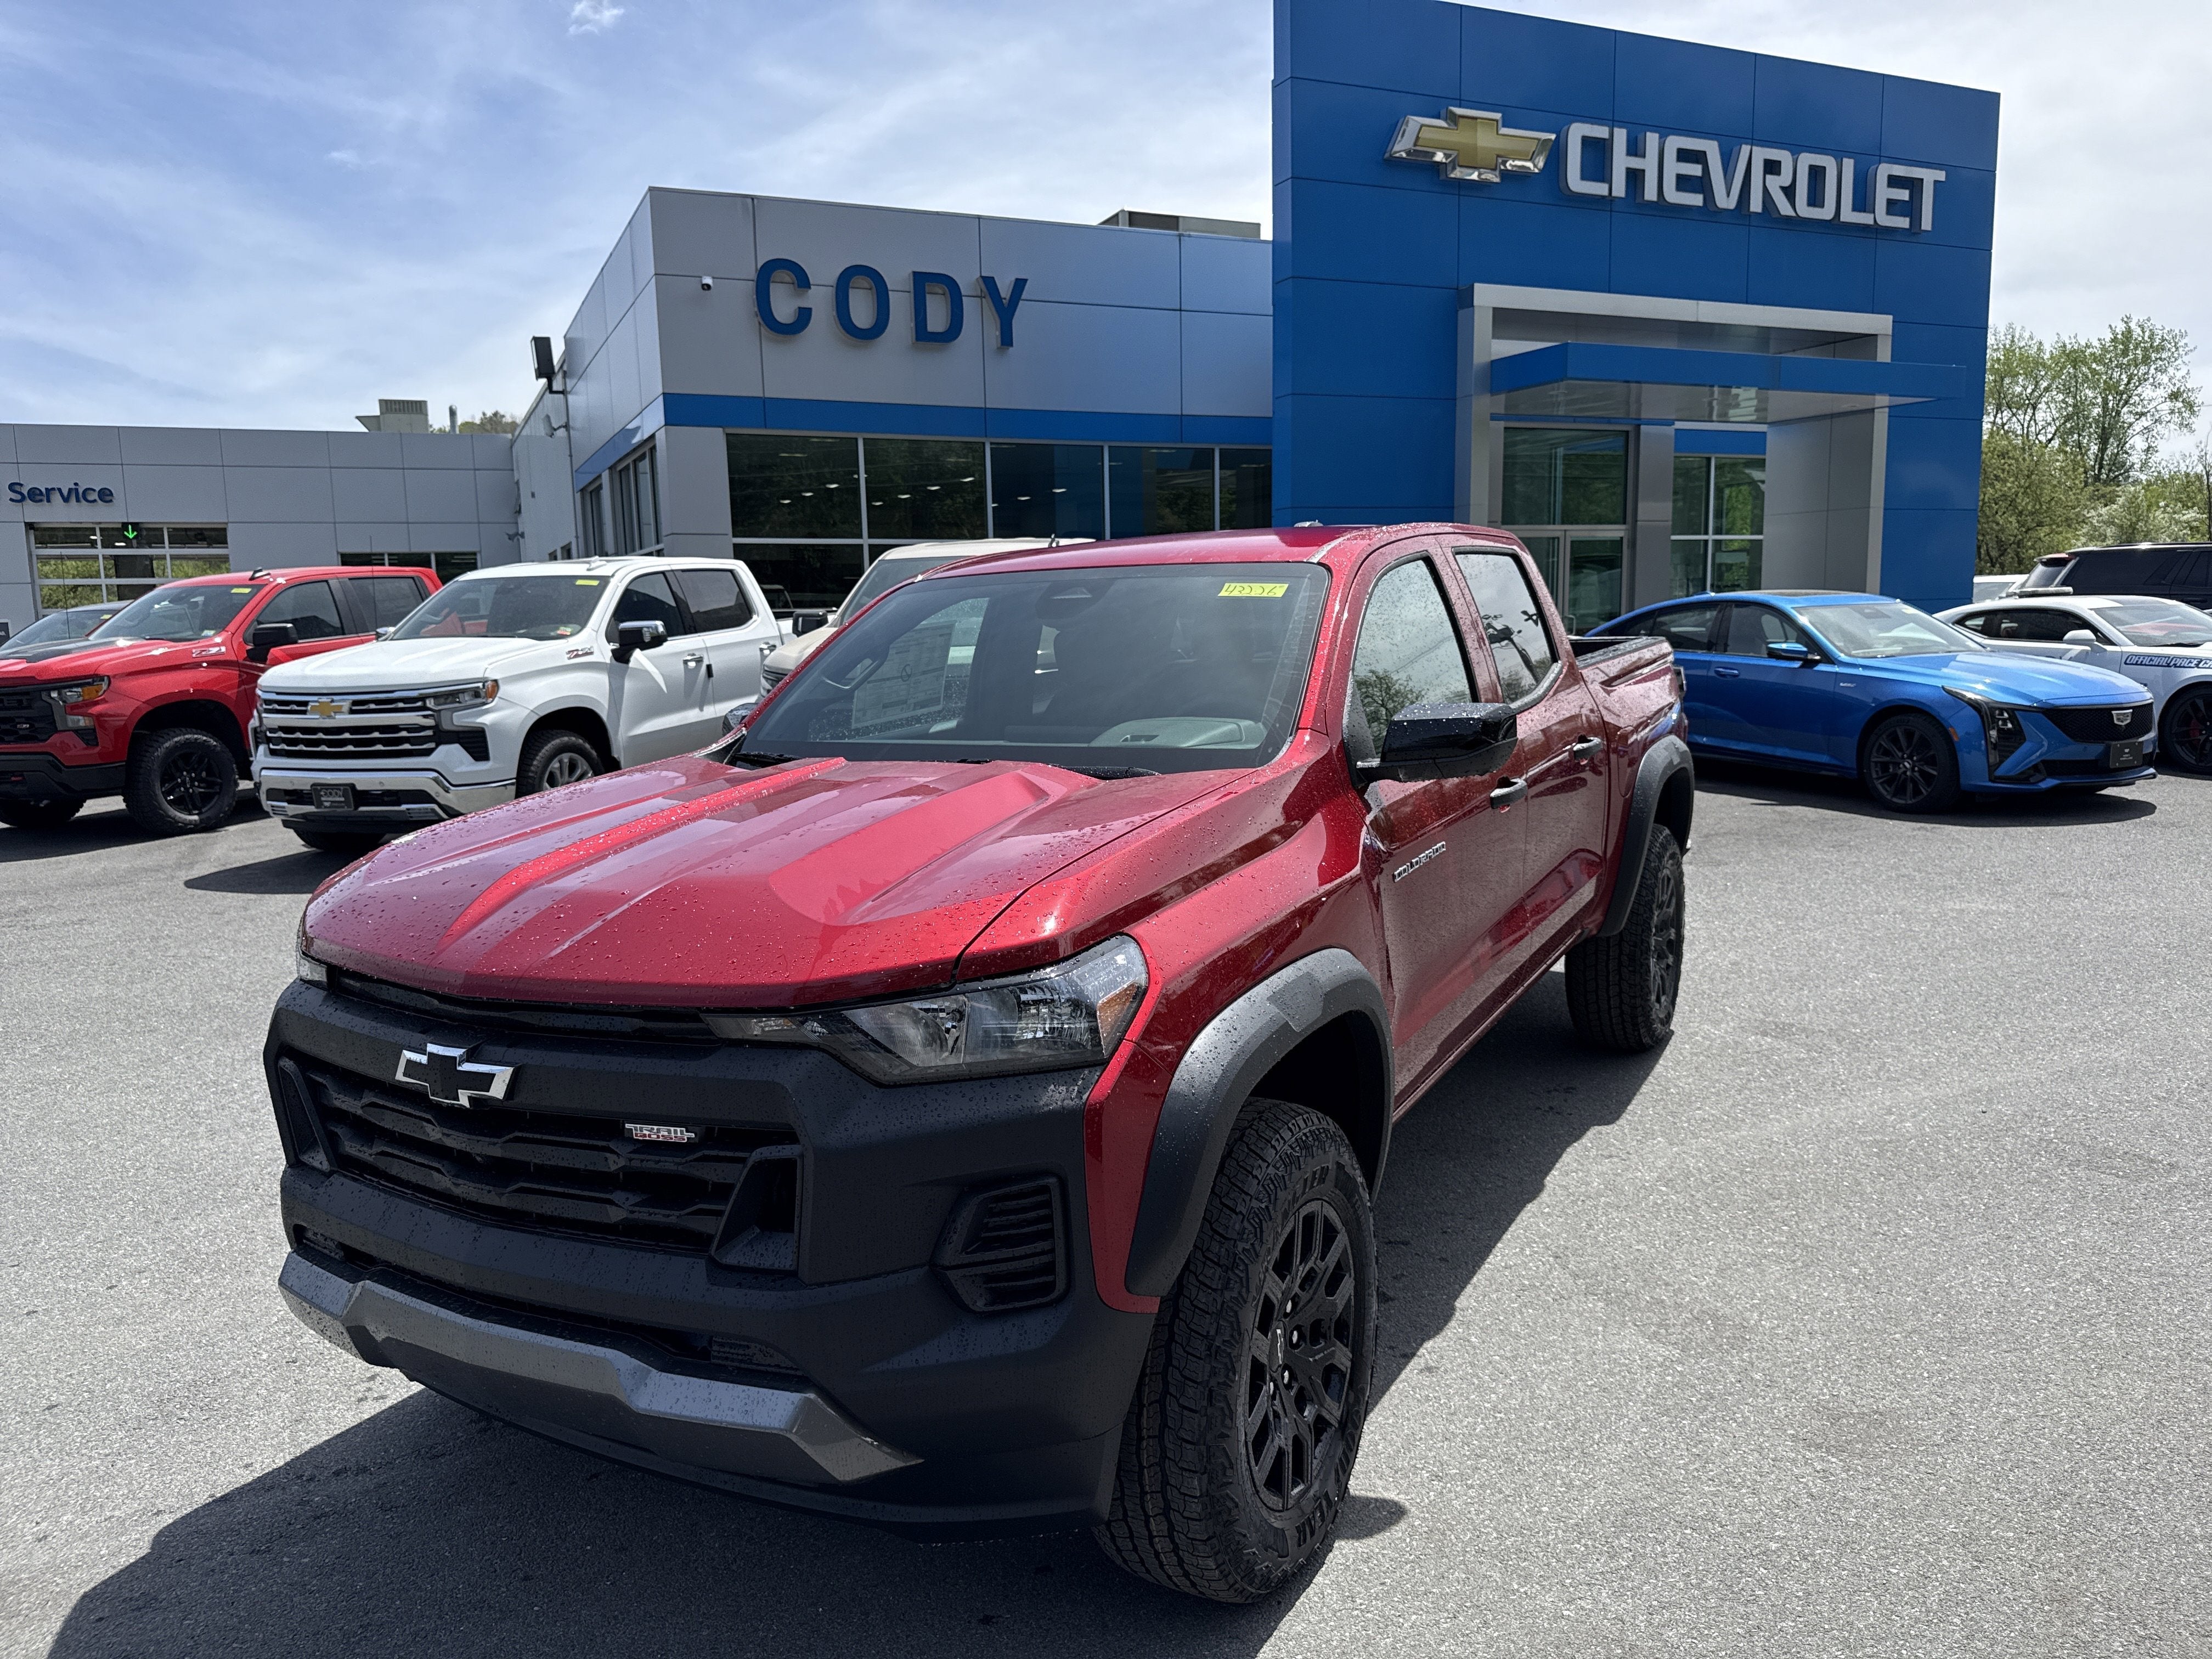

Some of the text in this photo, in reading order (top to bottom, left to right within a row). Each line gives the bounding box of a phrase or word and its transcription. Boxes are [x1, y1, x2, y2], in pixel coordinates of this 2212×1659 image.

[1559, 122, 1946, 233] CHEVROLET
[754, 258, 1029, 349] CODY
[8, 482, 114, 504] Service
[2126, 655, 2170, 666] OFFICIAL
[2169, 658, 2200, 667] PACE
[625, 1123, 695, 1138] TRAIL
[634, 1132, 687, 1142] BOSS
